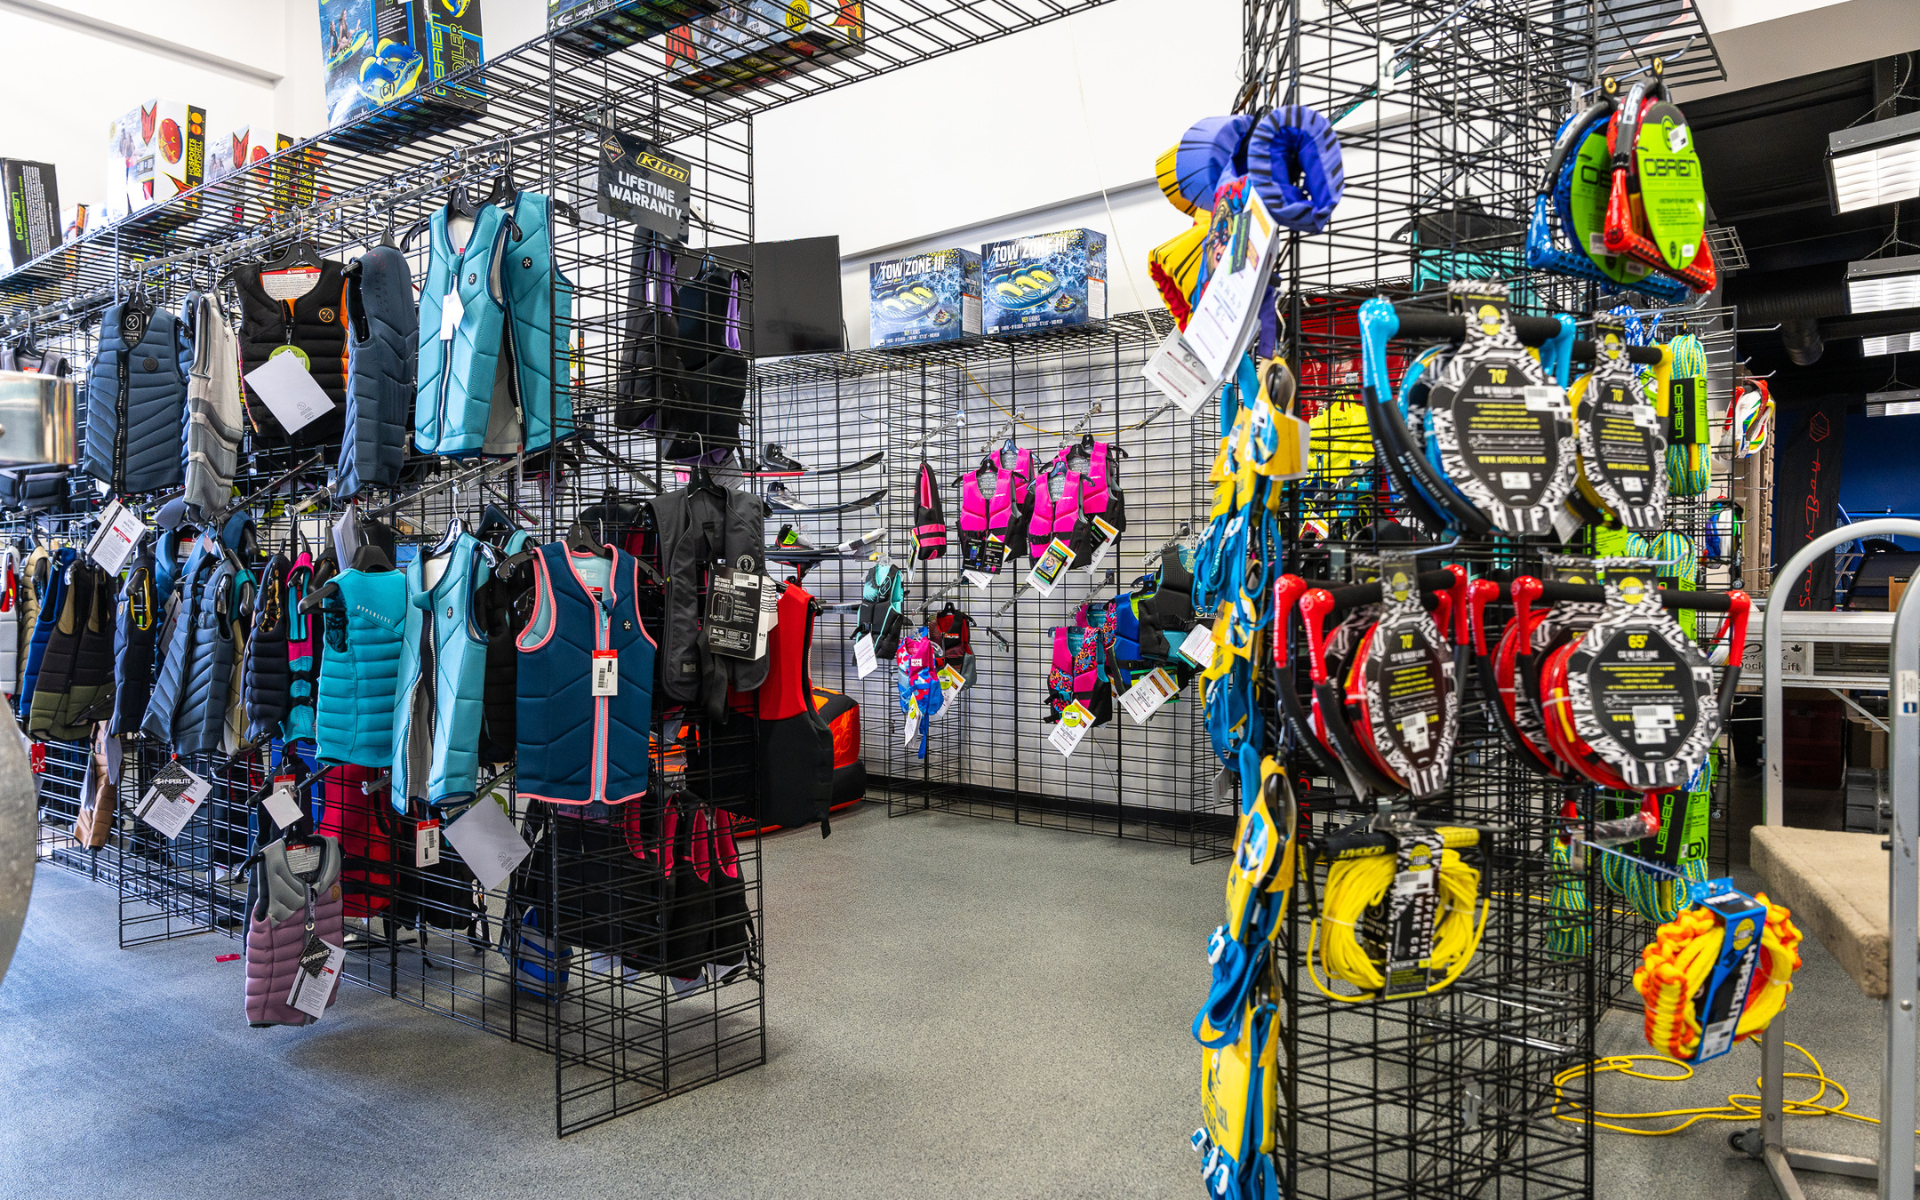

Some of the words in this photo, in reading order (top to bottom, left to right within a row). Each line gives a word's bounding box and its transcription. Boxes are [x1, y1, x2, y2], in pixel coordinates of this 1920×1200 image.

[608, 183, 682, 221] WARRANTY
[618, 170, 676, 203] LIFETIME
[992, 244, 1019, 263] TOW
[1022, 239, 1054, 259] ZONE
[1055, 235, 1067, 253] III
[880, 264, 903, 280] TOW
[905, 257, 932, 276] ZONE
[934, 255, 945, 272] III
[1673, 384, 1685, 440] OBRIEN
[1628, 634, 1649, 649] 65'
[1655, 794, 1675, 855] OBRIEN
[1411, 895, 1425, 931] WAKE
